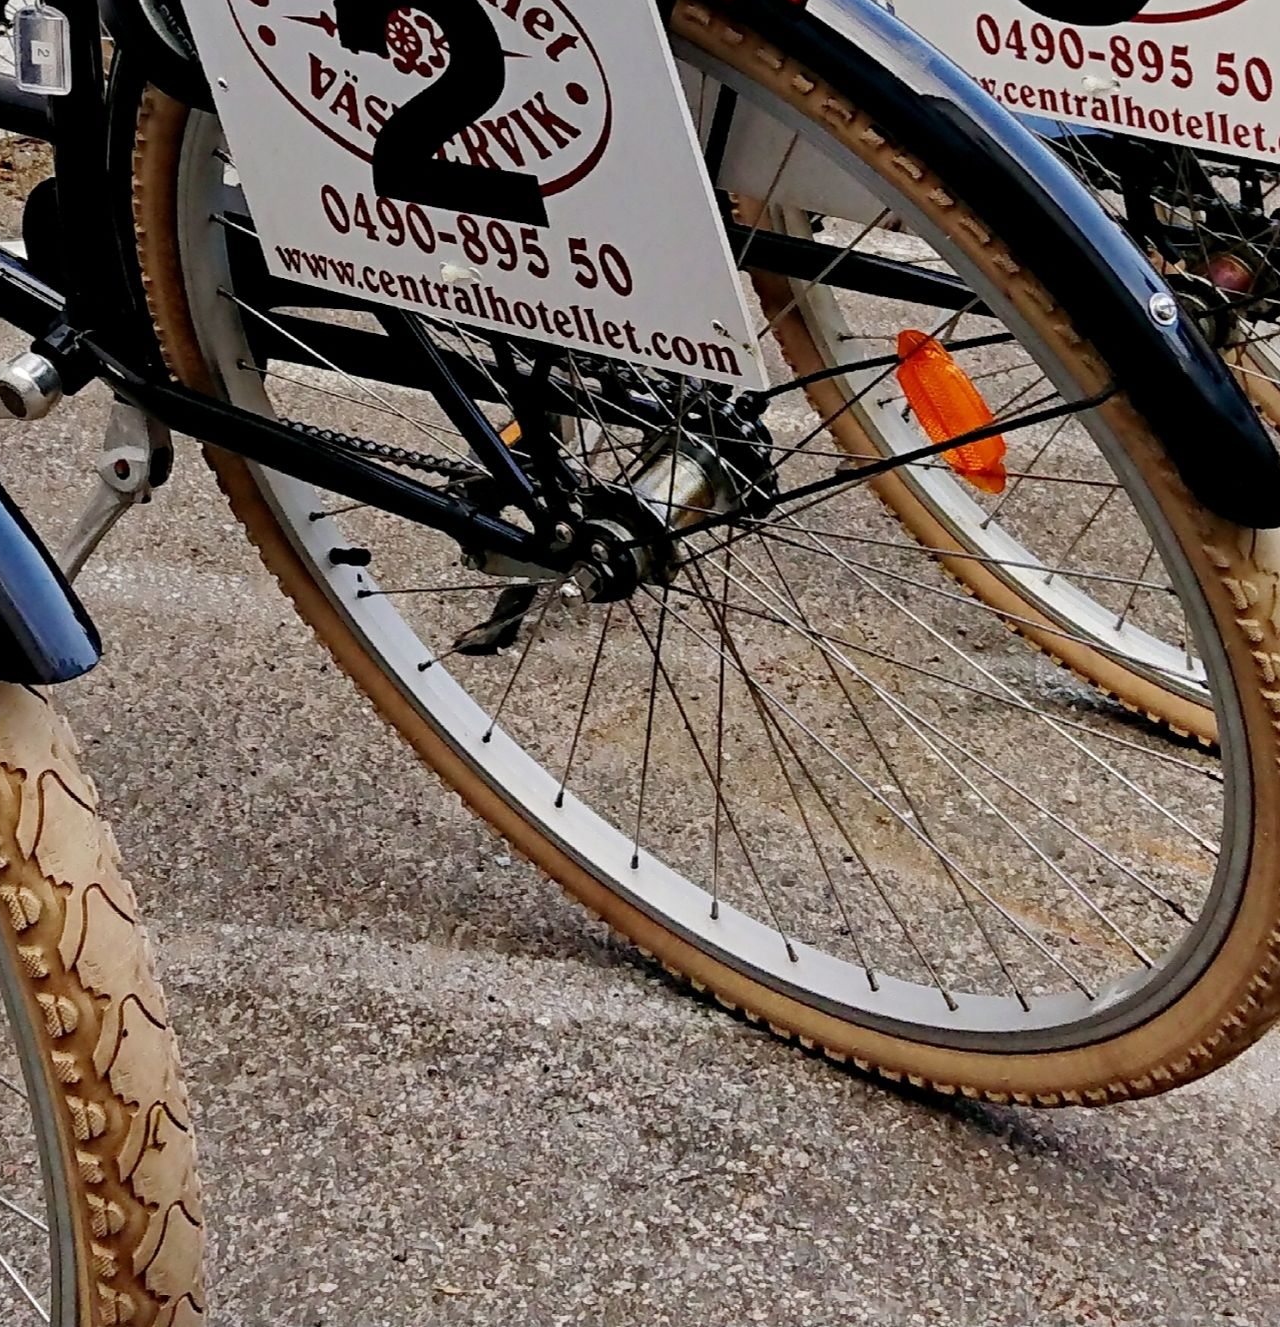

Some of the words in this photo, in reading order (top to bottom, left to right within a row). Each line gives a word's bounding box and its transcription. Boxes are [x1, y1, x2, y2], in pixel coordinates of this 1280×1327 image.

[308, 52, 582, 172] VÄSRVIK
[976, 13, 1194, 89] 0490-895
[1216, 51, 1273, 102] 50
[320, 183, 550, 279] 0490-895
[568, 236, 634, 297] 50
[274, 243, 743, 377] www.centralhotellet.com
